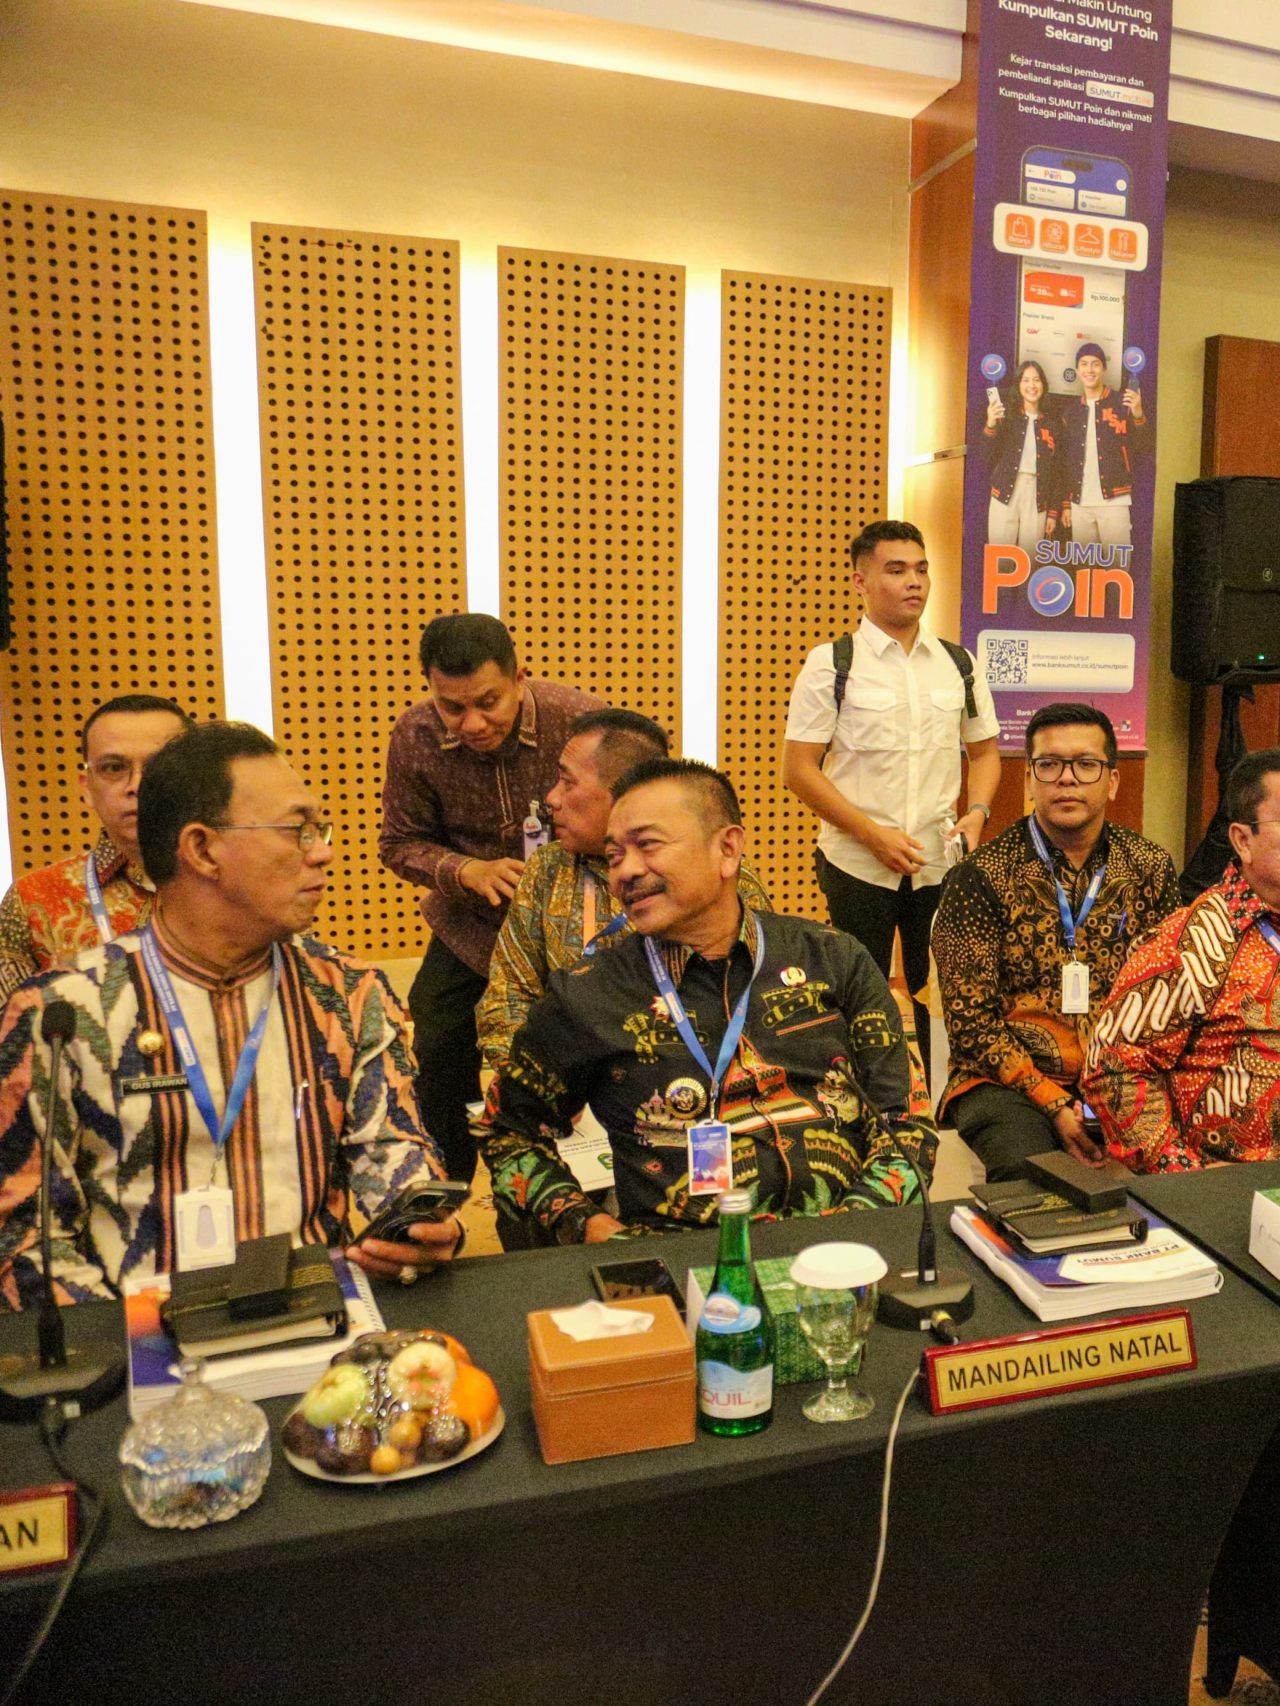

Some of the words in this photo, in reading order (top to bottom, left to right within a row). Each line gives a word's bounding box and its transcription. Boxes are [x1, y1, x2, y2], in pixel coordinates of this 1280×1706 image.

[998, 0, 1075, 24] Kumpulkan
[1076, 13, 1128, 34] SUMUT
[1130, 24, 1158, 41] Poin
[1107, 2, 1152, 23] Untung
[1045, 25, 1113, 52] Sekarang!
[1010, 53, 1033, 67] Kejar
[1034, 58, 1073, 74] transaksi
[1074, 68, 1127, 84] pembayaran
[1128, 77, 1144, 88] dan
[999, 87, 1047, 105] Kumpulkan
[1048, 96, 1083, 111] SUMUT
[1083, 102, 1103, 114] Poin
[1104, 106, 1121, 117] dan
[1122, 110, 1153, 124] nikmati
[1053, 79, 1085, 92] aplikasi
[1090, 87, 1121, 100] SUMUT
[1018, 104, 1057, 120] berbagai
[1058, 111, 1087, 124] pilihan
[1088, 116, 1134, 132] hadiahnya!
[1035, 539, 1134, 568] SUMUT
[982, 543, 1134, 620] Poin
[947, 1344, 1102, 1392] MANDAILING
[1109, 1331, 1182, 1364] NATAL
